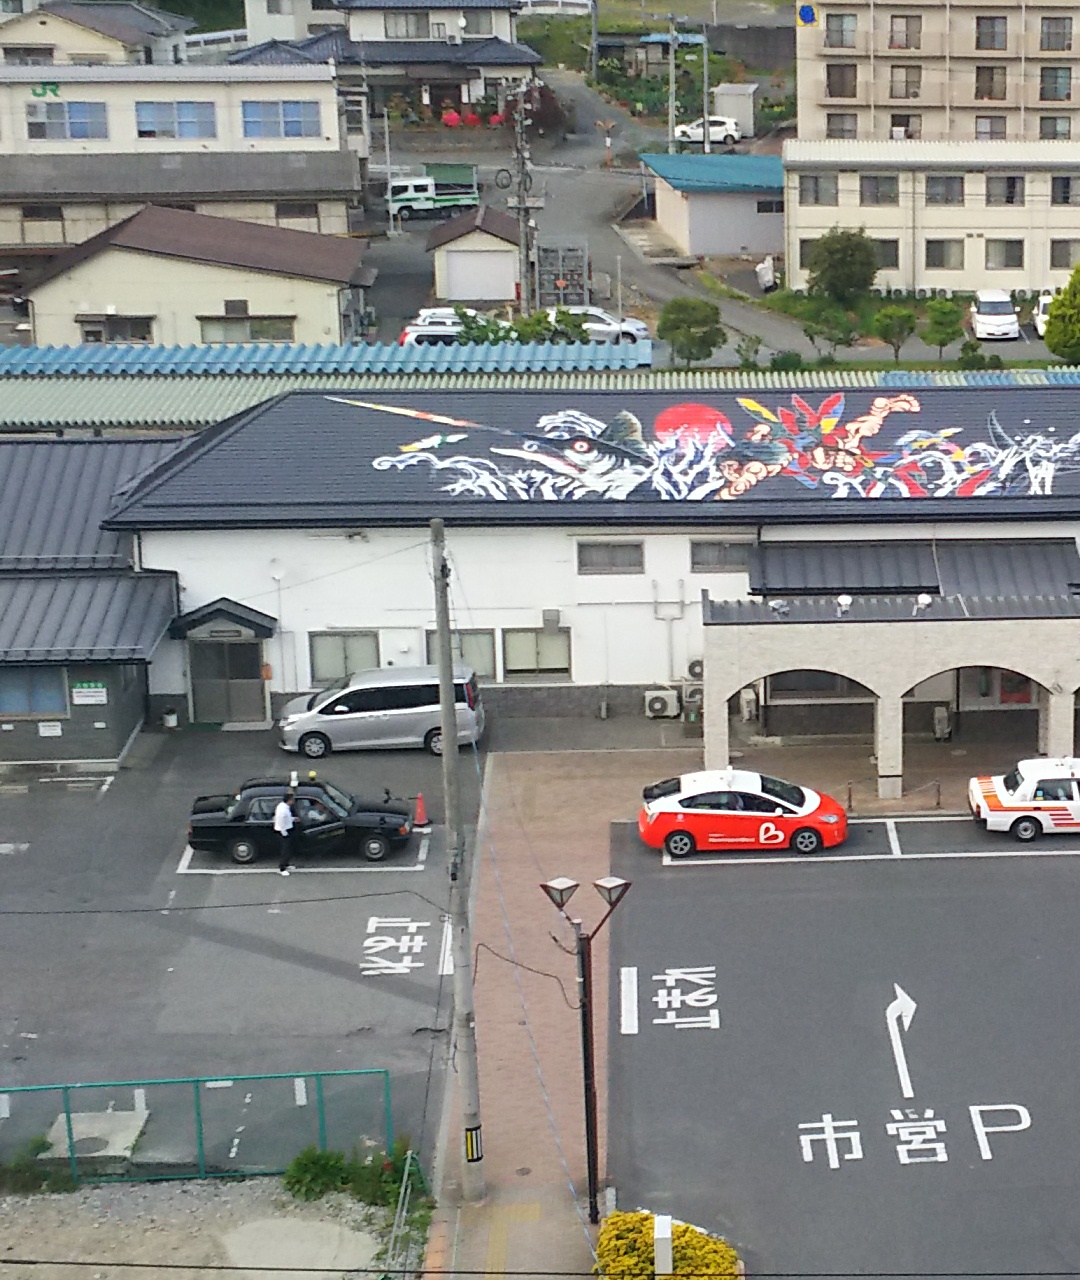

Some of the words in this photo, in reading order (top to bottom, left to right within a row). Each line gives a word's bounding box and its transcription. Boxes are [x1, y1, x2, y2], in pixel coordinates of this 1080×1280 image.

[31, 81, 60, 98] JR
[359, 916, 432, 976] 止まれ
[651, 965, 720, 1029] 止まれ
